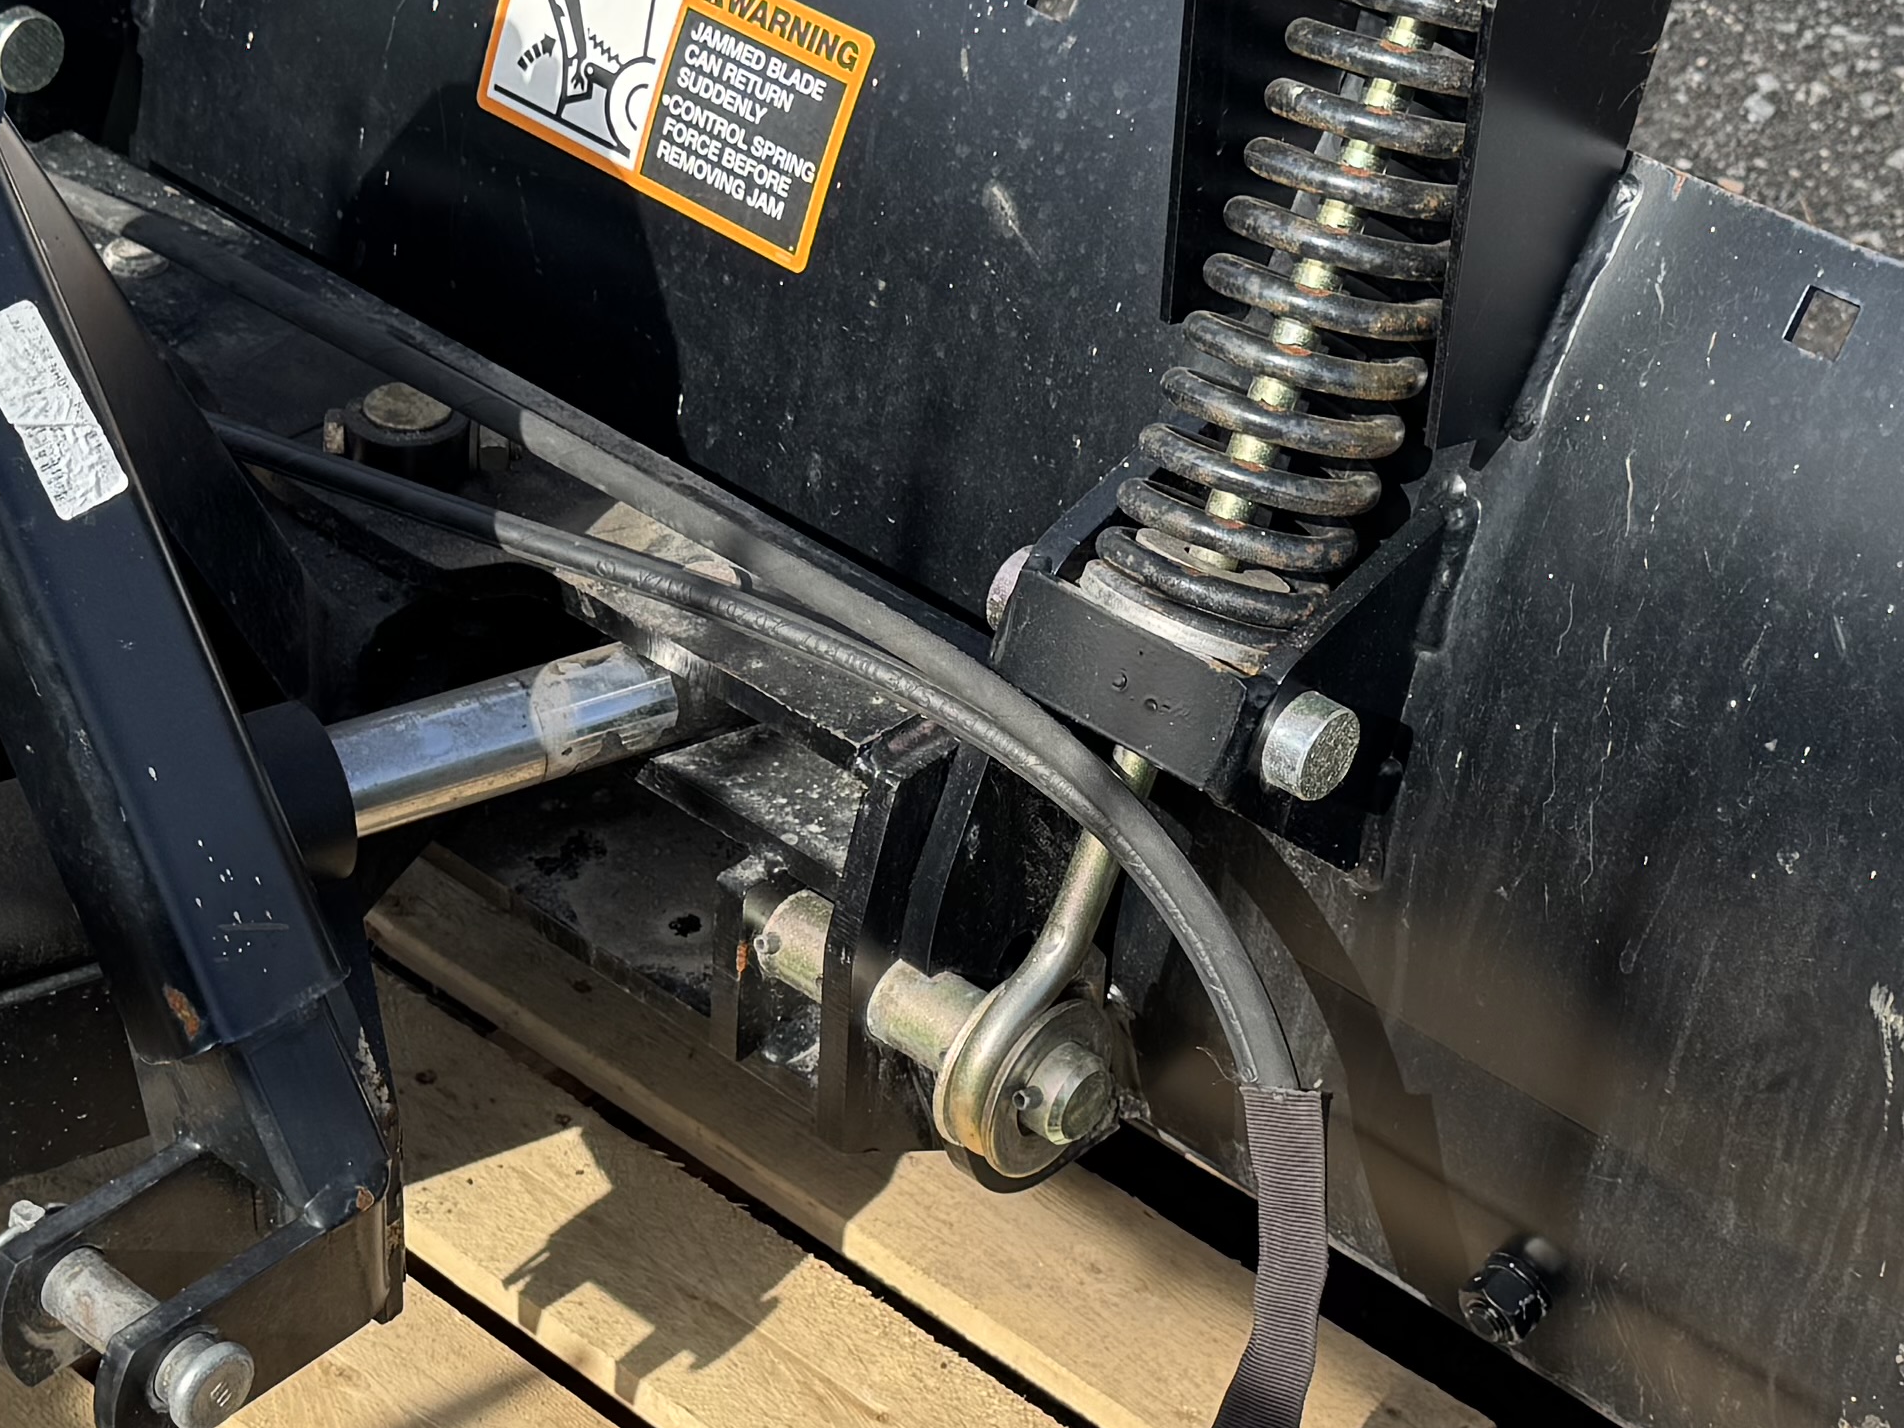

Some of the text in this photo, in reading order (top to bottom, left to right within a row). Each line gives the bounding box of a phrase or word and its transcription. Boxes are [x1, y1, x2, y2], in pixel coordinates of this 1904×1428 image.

[676, 66, 768, 124] SUDDENLY
[683, 43, 794, 112] CAN RETURN
[690, 21, 827, 101] JAMMED BLADE
[661, 115, 792, 197] FORCE BEFORE
[668, 93, 816, 183] CONTROL SPRING
[655, 138, 785, 220] REMOVING JAM
